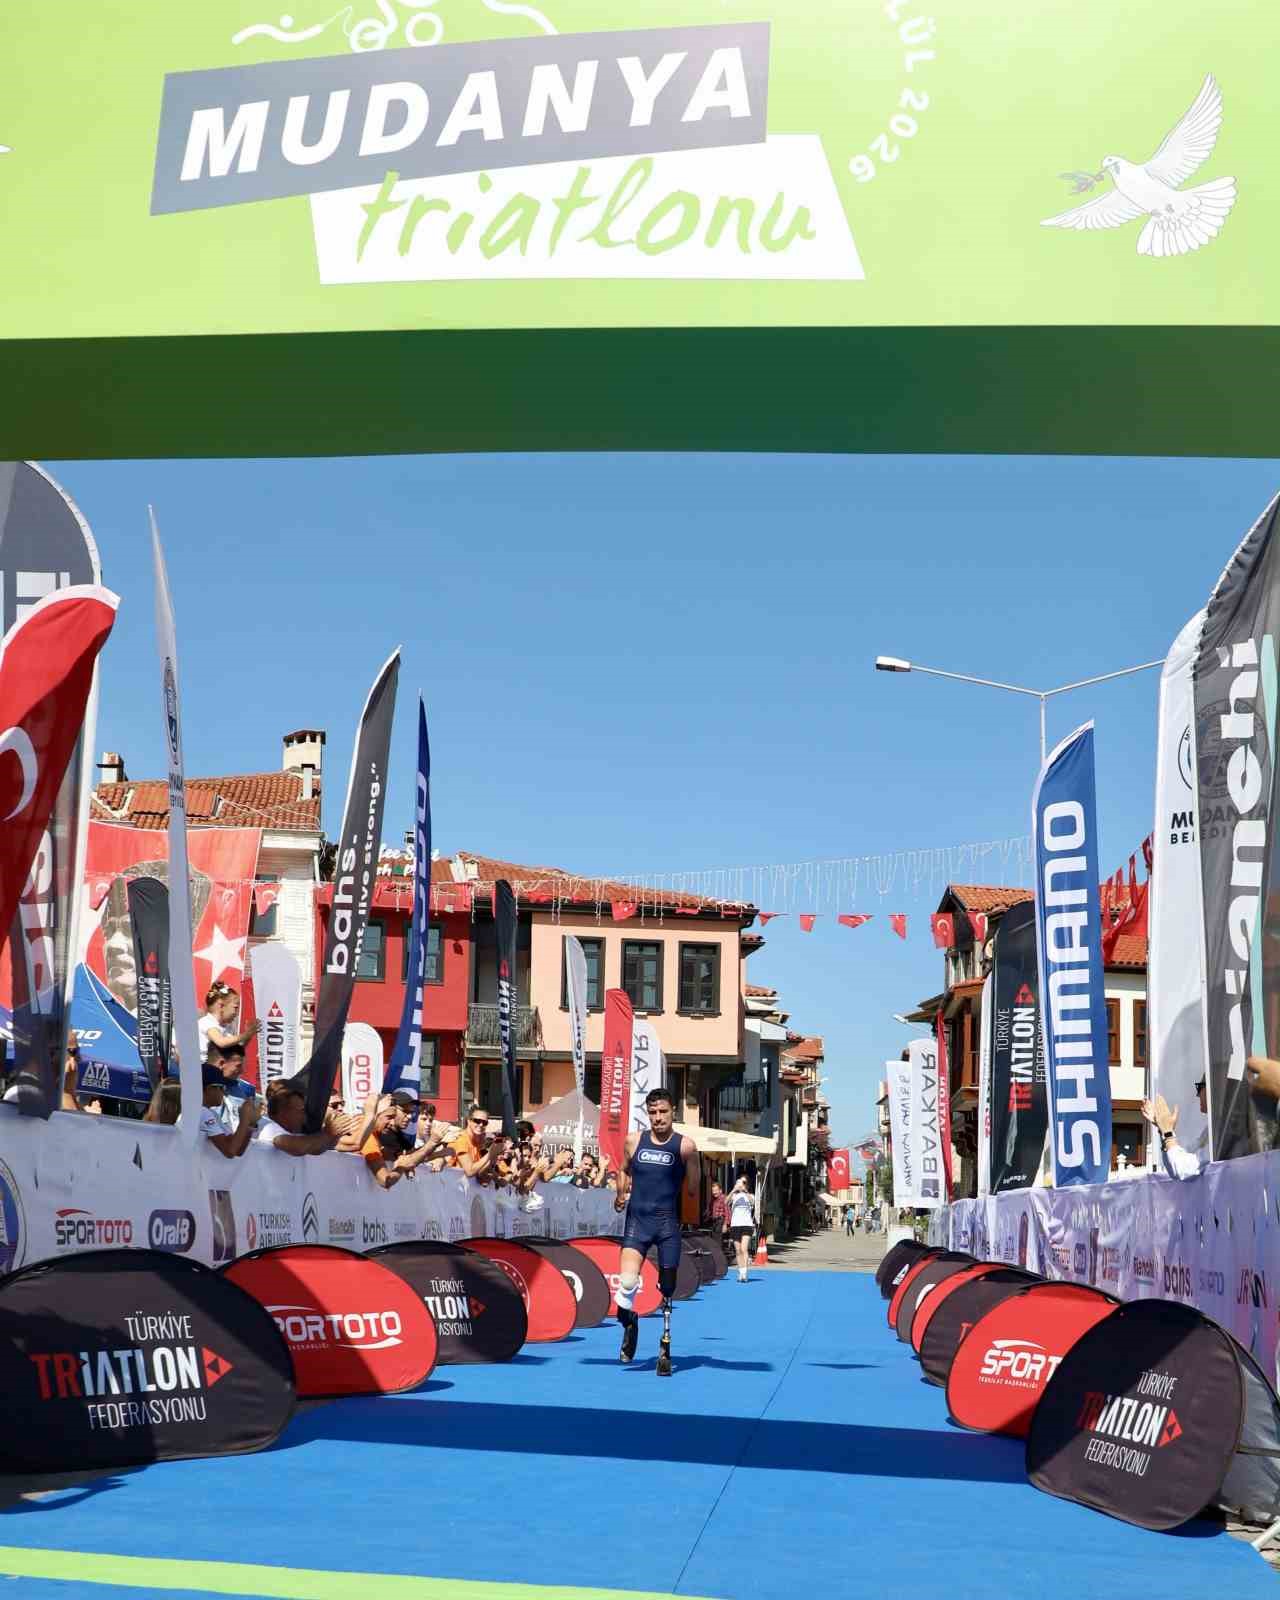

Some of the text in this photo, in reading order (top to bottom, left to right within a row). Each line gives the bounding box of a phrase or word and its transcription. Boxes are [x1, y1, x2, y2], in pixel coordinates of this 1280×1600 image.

[179, 46, 753, 183] MUDANYA
[848, 0, 936, 183] LÜL 2026
[356, 157, 817, 264] triatlonu
[1044, 800, 1101, 1168] SHIMANO
[1008, 1007, 1036, 1113] TRİATLON
[55, 1219, 133, 1246] SPORTOTO
[430, 1276, 465, 1294] TÜRKİYE
[124, 1310, 194, 1341] TÜRKİYE
[273, 1311, 402, 1342] PORTOTO
[30, 1346, 201, 1400] TRİATLON
[1136, 1368, 1178, 1400] TÜRKİYE
[88, 1396, 207, 1431] FEDERASYONU
[1078, 1391, 1168, 1447] TRİATLON
[1084, 1437, 1151, 1477] FEDERASYONU
